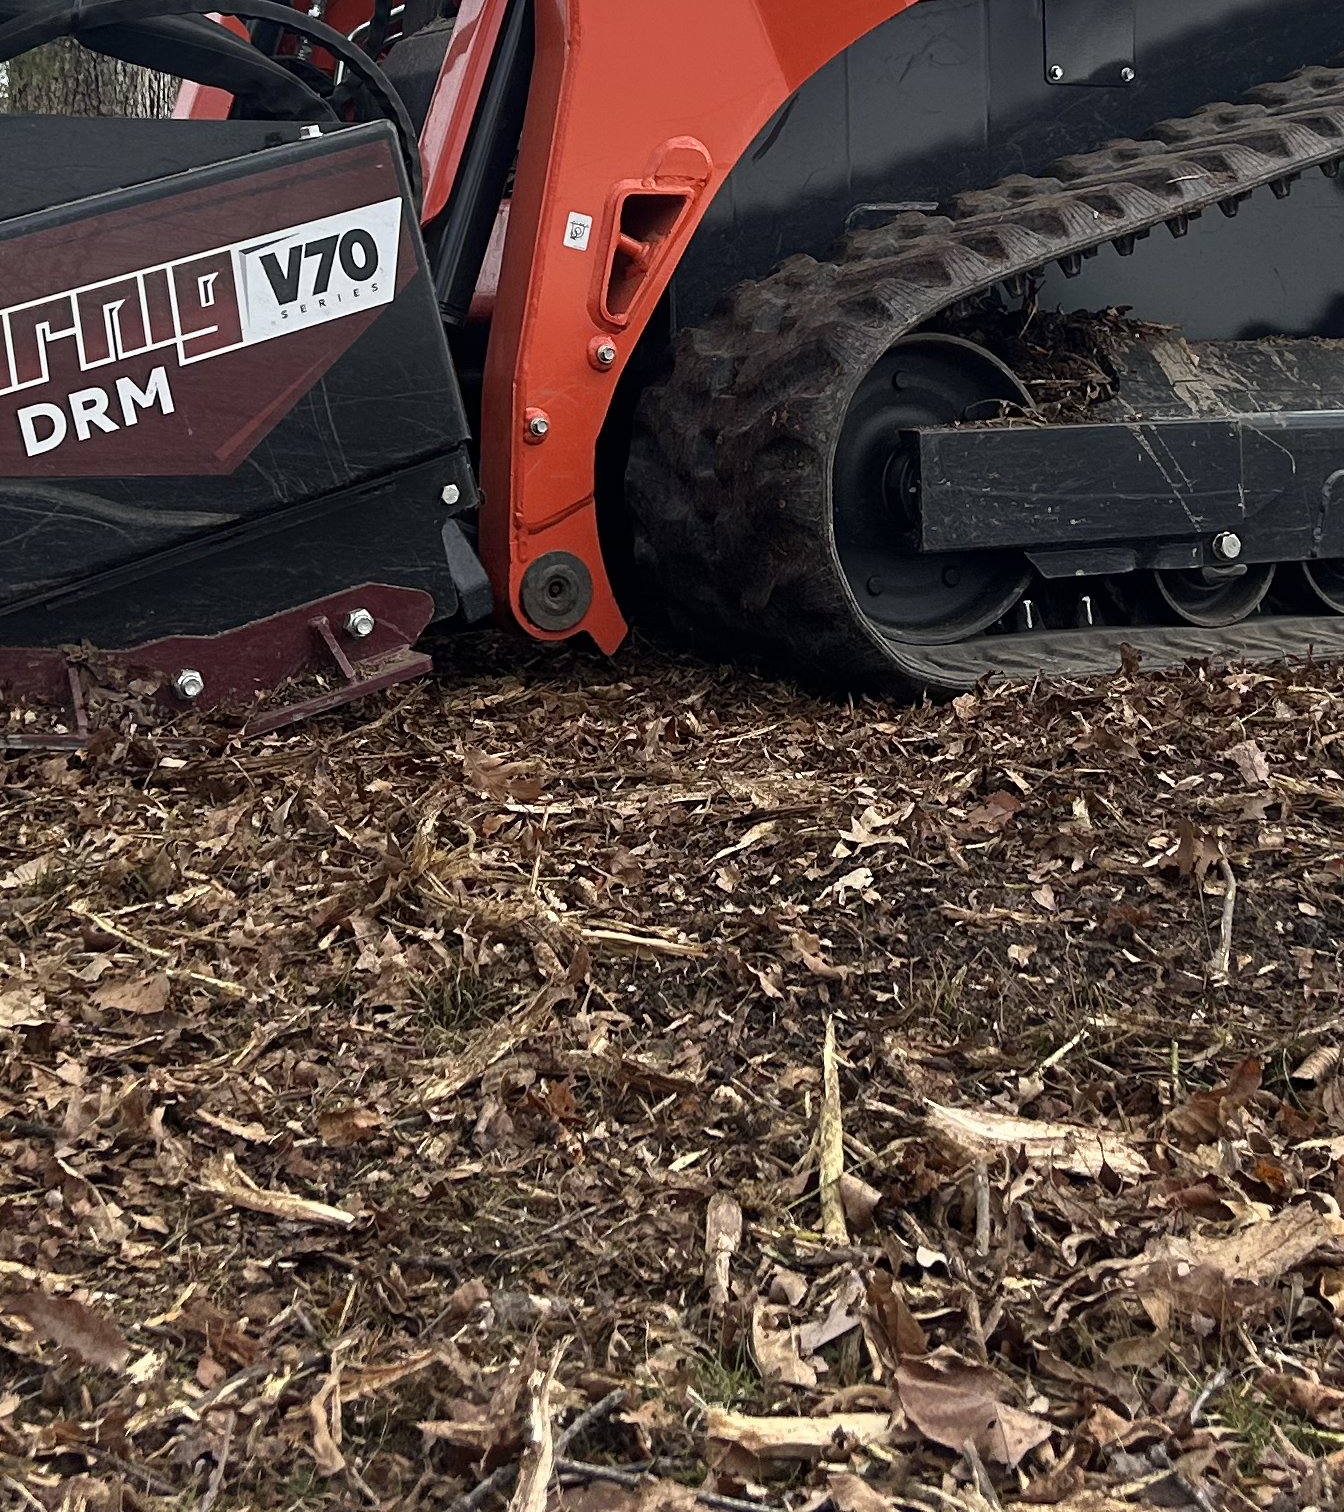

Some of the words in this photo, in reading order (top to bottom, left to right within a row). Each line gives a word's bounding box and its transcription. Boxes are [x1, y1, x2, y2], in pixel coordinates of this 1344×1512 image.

[259, 228, 379, 306] V70
[280, 283, 379, 319] SERIES
[17, 365, 175, 457] DRM
